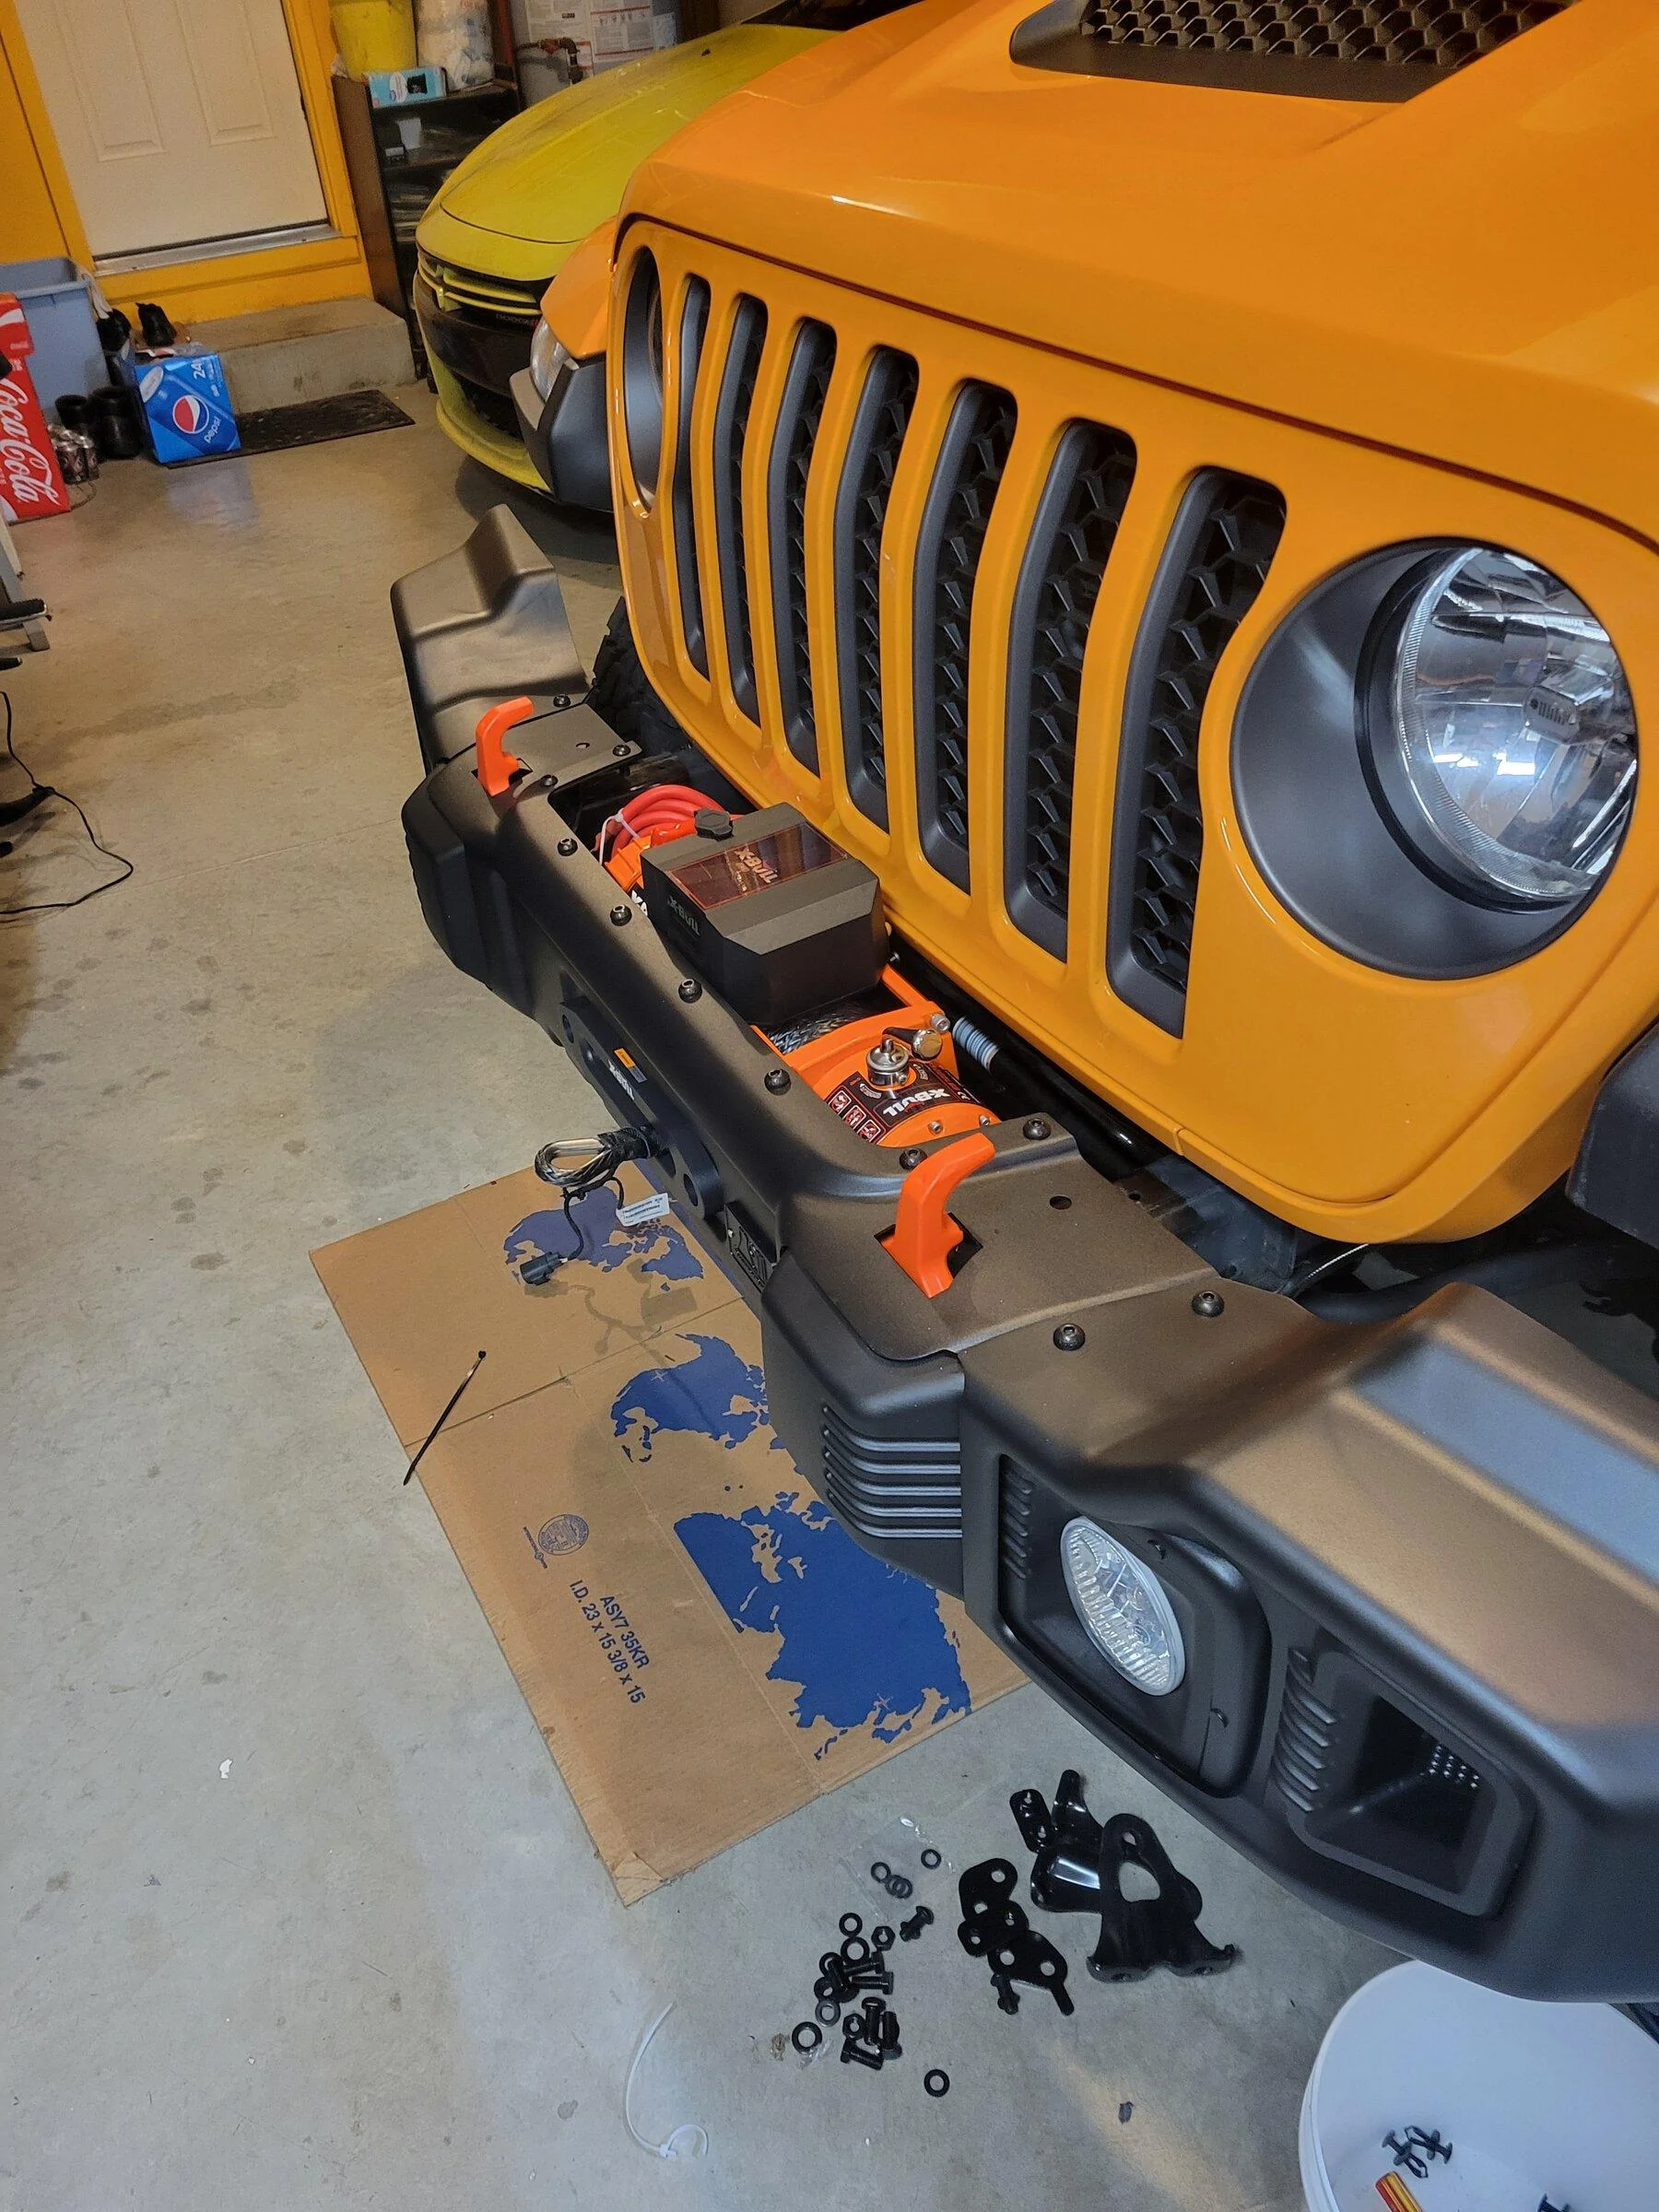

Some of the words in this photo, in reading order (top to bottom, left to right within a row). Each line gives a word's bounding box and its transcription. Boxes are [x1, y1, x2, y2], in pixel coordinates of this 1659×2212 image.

[882, 1088, 950, 1117] X-BULL
[582, 1603, 600, 1621] 23
[598, 1631, 617, 1650] 15
[627, 1685, 646, 1704] 15
[621, 1631, 650, 1669] 35KR
